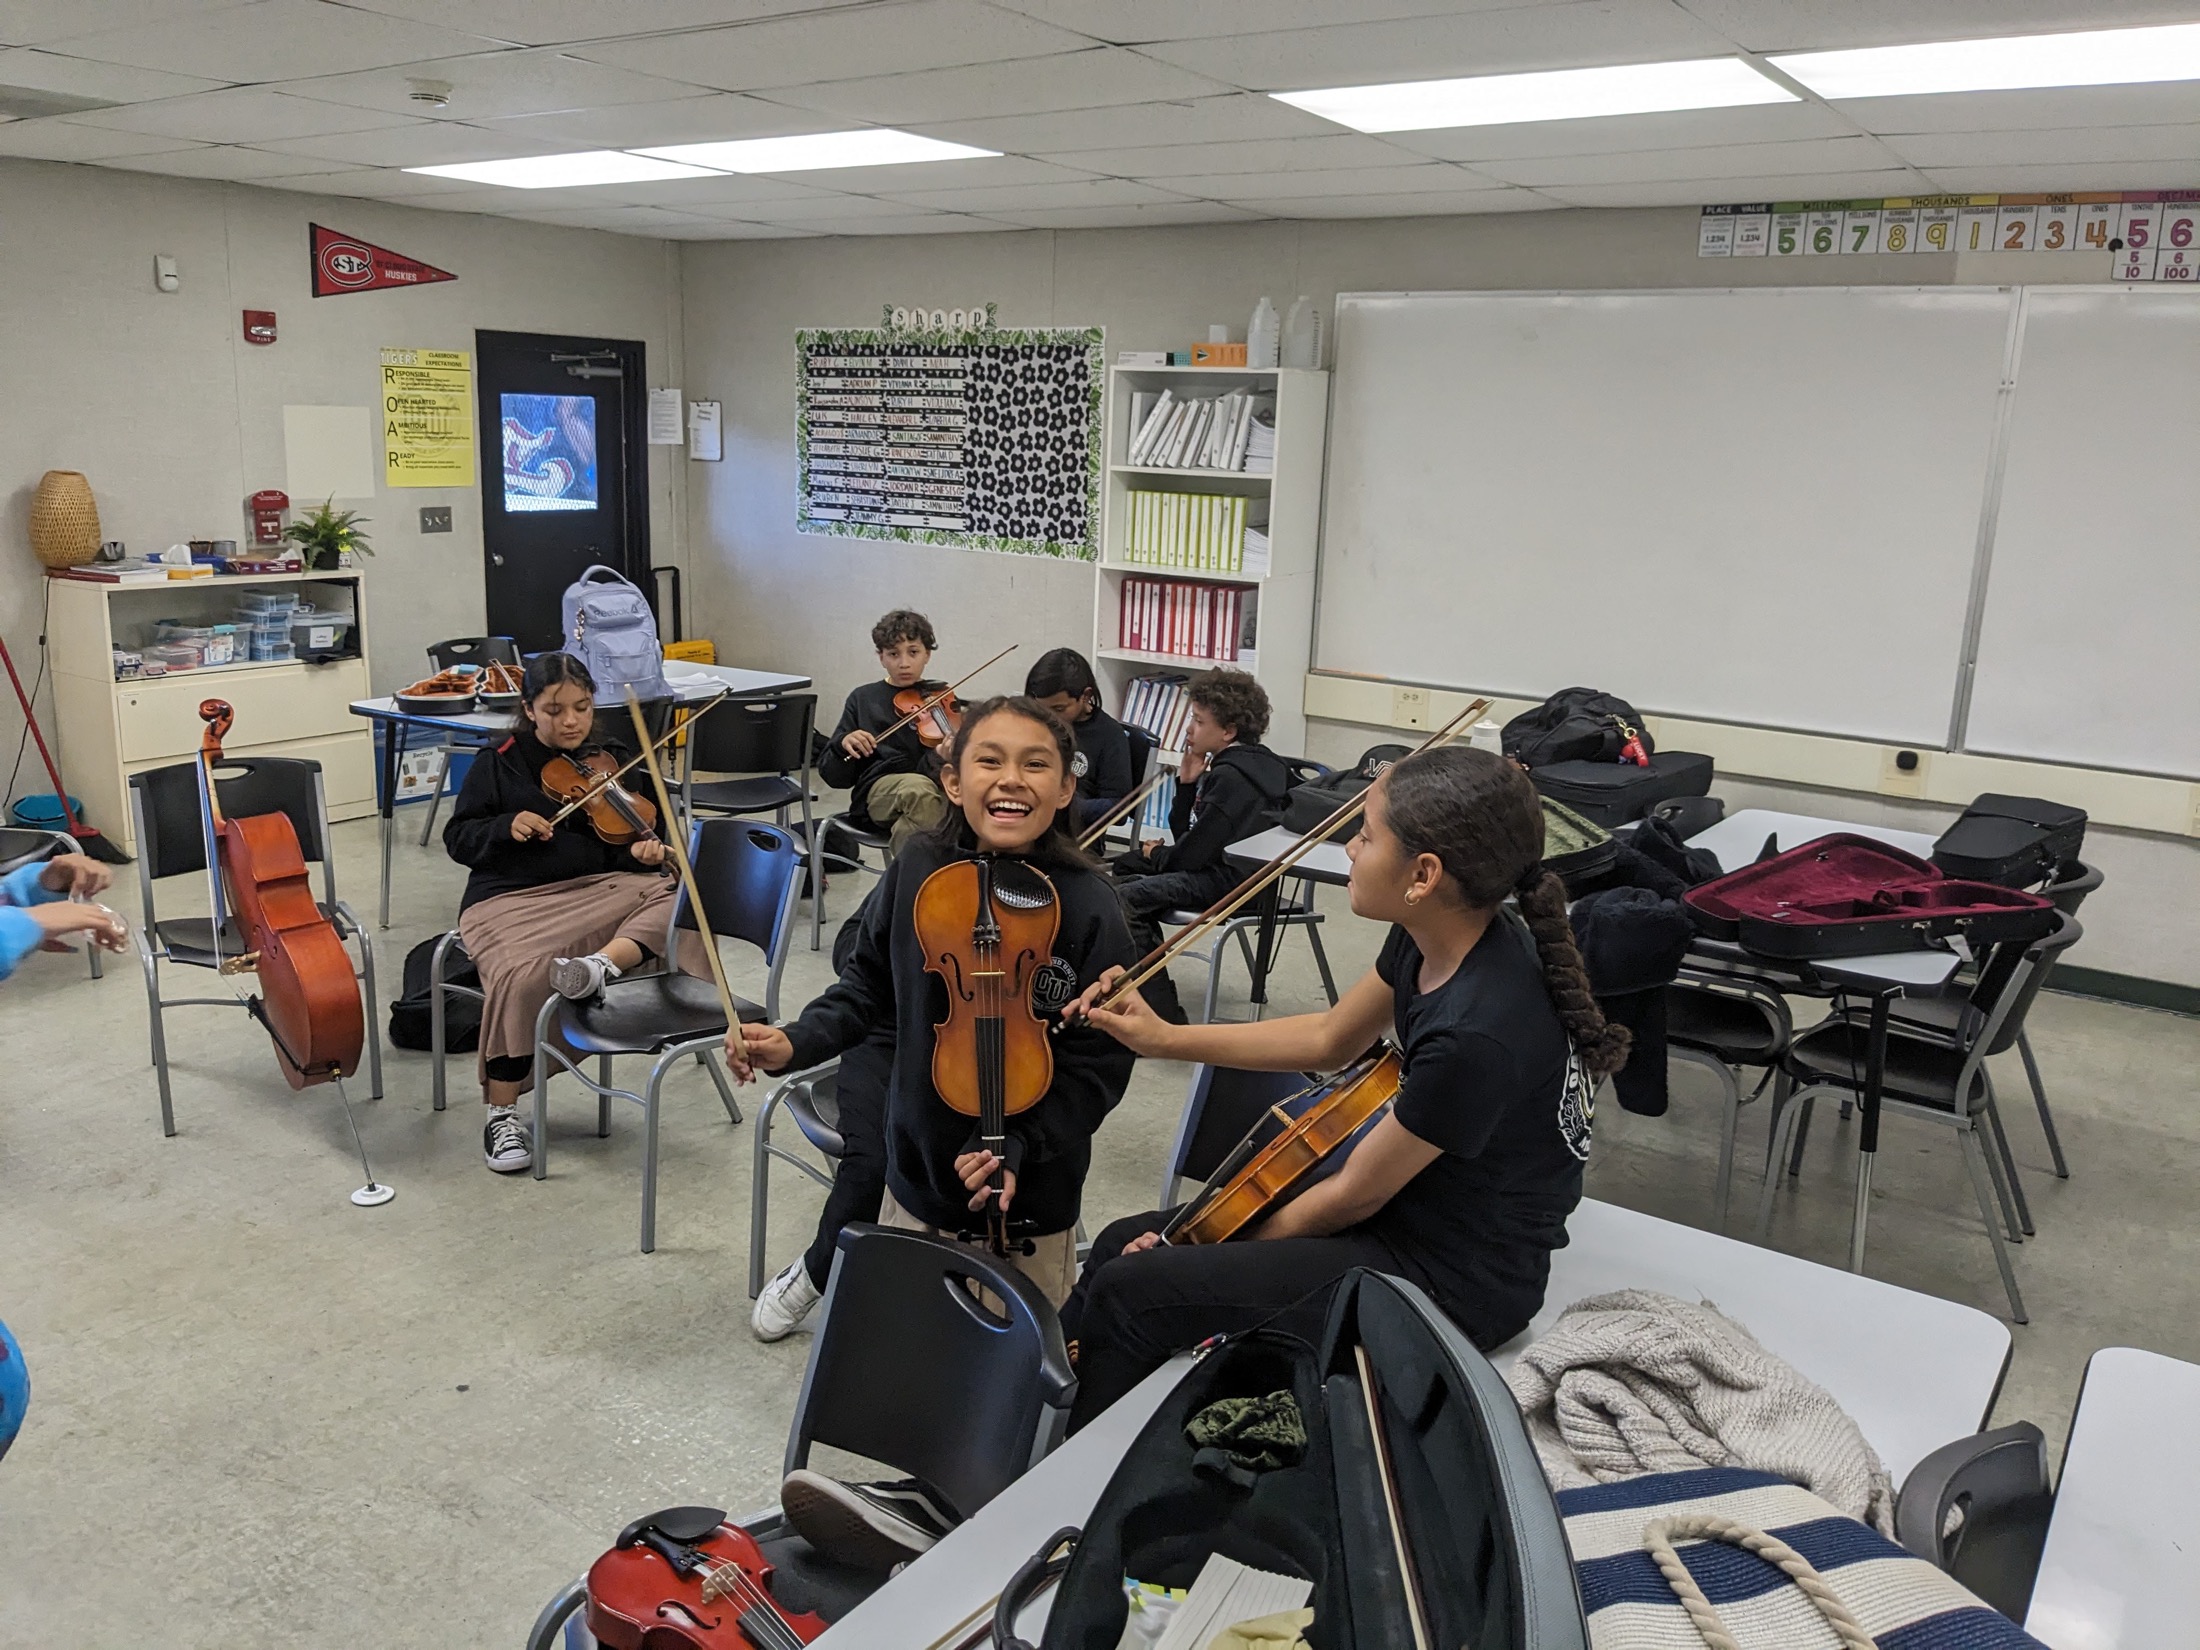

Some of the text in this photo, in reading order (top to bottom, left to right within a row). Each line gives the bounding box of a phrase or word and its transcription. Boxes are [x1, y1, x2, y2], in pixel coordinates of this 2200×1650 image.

[1706, 204, 1766, 214] PLACE VALUE
[1803, 200, 1851, 210] MILLIONS
[1911, 197, 1970, 206] THOUSANDS
[2045, 194, 2073, 203] ONES
[1777, 228, 1796, 254] 5
[1813, 226, 1833, 253] 6
[1852, 225, 1869, 252] 7
[1887, 224, 1907, 251] 8
[1926, 223, 1947, 250] 9
[1969, 222, 1980, 249] 1
[2004, 221, 2026, 248] 2
[2044, 220, 2065, 248] 3
[2085, 219, 2107, 248] 4
[2127, 219, 2149, 248] 5
[2170, 218, 2194, 247] 6
[2129, 251, 2140, 263] 5
[2173, 252, 2183, 264] 6
[385, 269, 417, 281] HUSKIES
[2125, 266, 2140, 278] 10
[2164, 267, 2189, 279] 100
[896, 309, 982, 326] sharp
[380, 352, 418, 366] TIGERS
